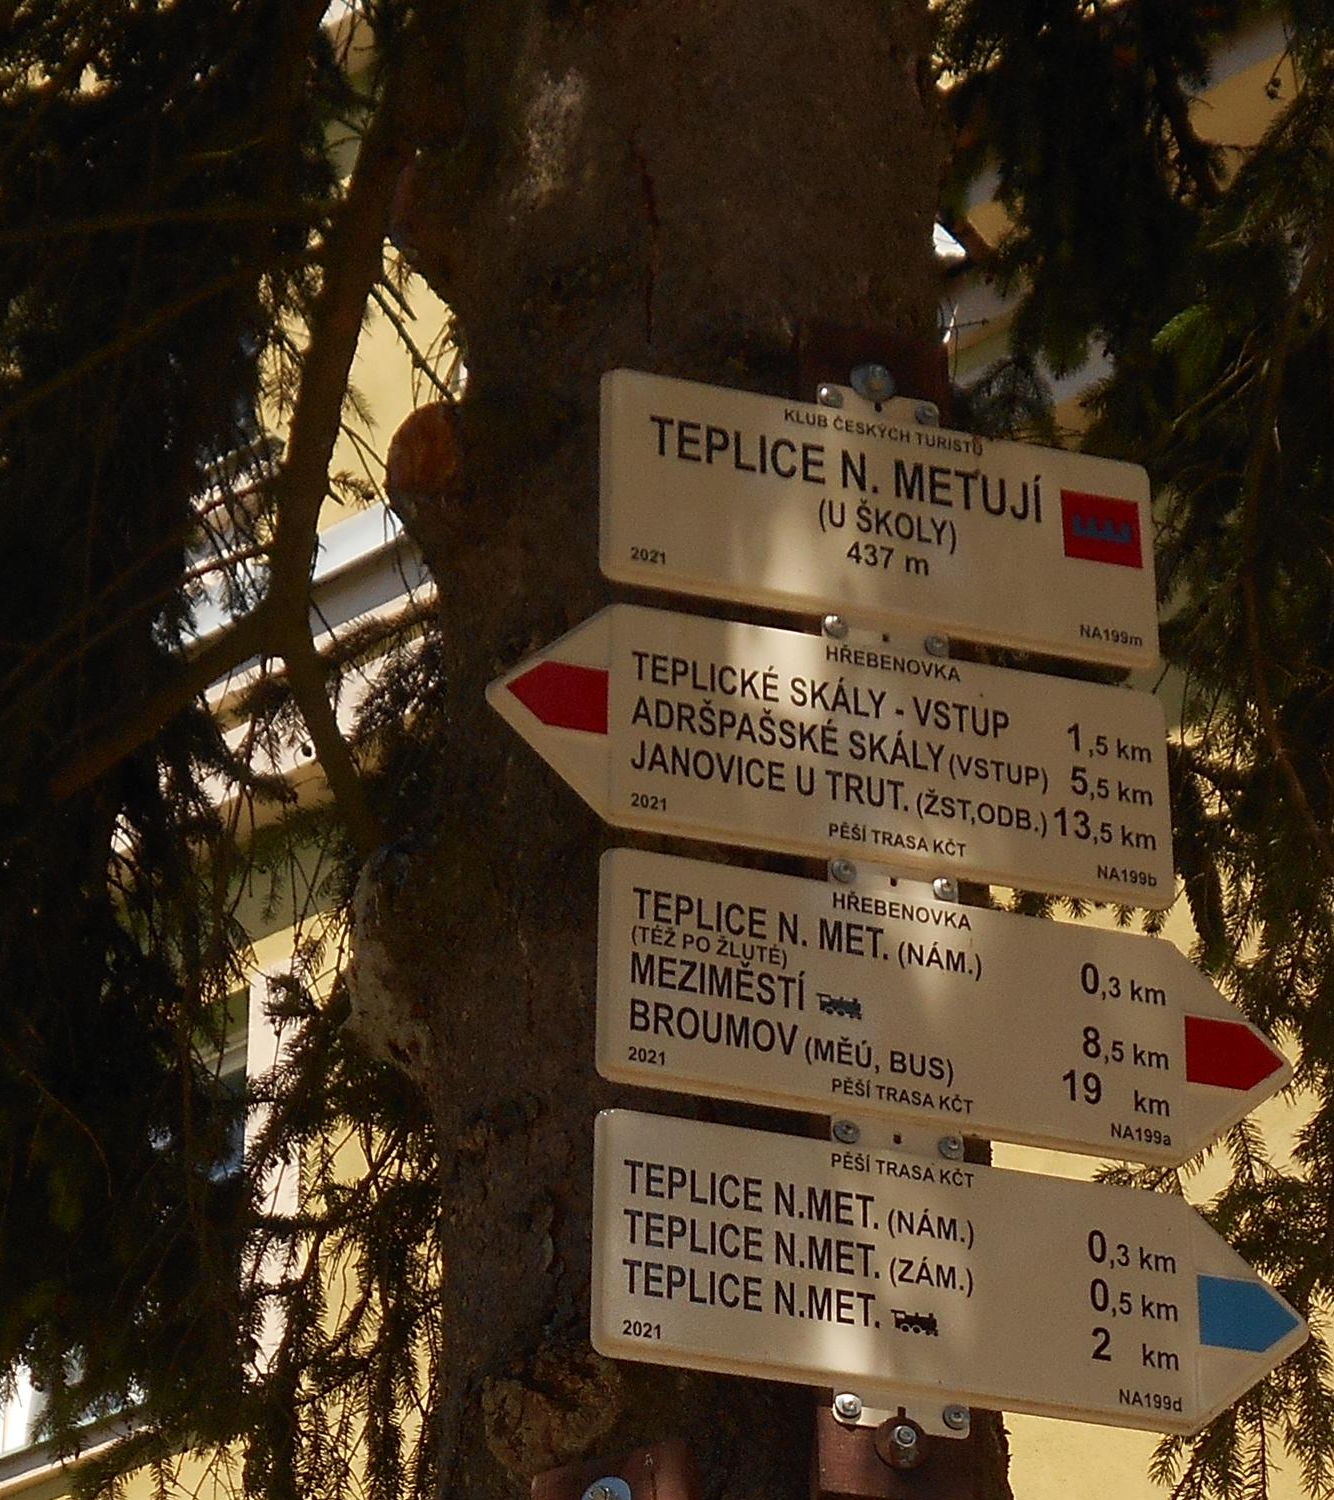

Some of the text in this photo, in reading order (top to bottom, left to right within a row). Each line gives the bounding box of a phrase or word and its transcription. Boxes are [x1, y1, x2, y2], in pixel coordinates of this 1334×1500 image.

[784, 408, 828, 428] KLUB
[833, 413, 911, 443] ČESKÝCH
[649, 414, 1042, 523] TEPLICE N. METUJÍ
[819, 498, 957, 554] (U ŠKOLY)
[630, 546, 667, 565] 2021
[847, 541, 930, 576] 437 m
[1079, 624, 1143, 647] NA199m
[826, 644, 961, 682] HŘEBENOVKA
[631, 651, 780, 703] TEPLICKÉ
[790, 676, 887, 719] SKÁLY
[912, 696, 1010, 738] VSTUP
[1067, 723, 1109, 758] 1,5
[1117, 738, 1153, 763] km
[631, 696, 839, 757] ADRŠPAŠSKÉ
[1071, 766, 1110, 801] 5,5
[1118, 782, 1154, 806] km
[630, 740, 786, 793] JANOVICE
[796, 765, 815, 797] U
[825, 769, 909, 812] TRUT.
[1054, 807, 1113, 845] 13,5
[1121, 825, 1157, 850] km
[631, 793, 668, 811] 2021
[828, 822, 966, 857] PĚŠÍ TRASA KČT
[1097, 864, 1158, 887] NA199b
[832, 891, 972, 931] HŘEBENOVKA
[631, 925, 788, 970] (TÉŽ PO ŽLUTÉ)
[633, 887, 1167, 1006] TEPLICE N. MET. (NÁM.) 0,3 km
[630, 952, 1169, 1070] MEZIMĚSTÍ 8,5 km
[627, 1046, 666, 1066] 2021
[629, 998, 1171, 1117] BROUMOV (MĚÚ, BUS) 19 km
[832, 1077, 974, 1114] PĚŠÍ TRASA KČT
[1110, 1123, 1171, 1146] NA199a
[831, 1151, 975, 1188] PĚŠÍ TRASA KČT
[623, 1159, 763, 1213] TEPLICE
[887, 1208, 975, 1250] (NÁM.)
[1087, 1229, 1130, 1270] 0,3
[1139, 1246, 1177, 1274] km
[623, 1208, 763, 1262] TEPLICE
[889, 1257, 975, 1298] (ZÁM.)
[1090, 1278, 1132, 1318] 0,5
[1141, 1294, 1179, 1322] km
[622, 1258, 763, 1312] TEPLICE
[1091, 1327, 1112, 1361] 2
[1142, 1343, 1180, 1371] km
[622, 1319, 663, 1340] 2021
[1119, 1388, 1183, 1413] NA199d
